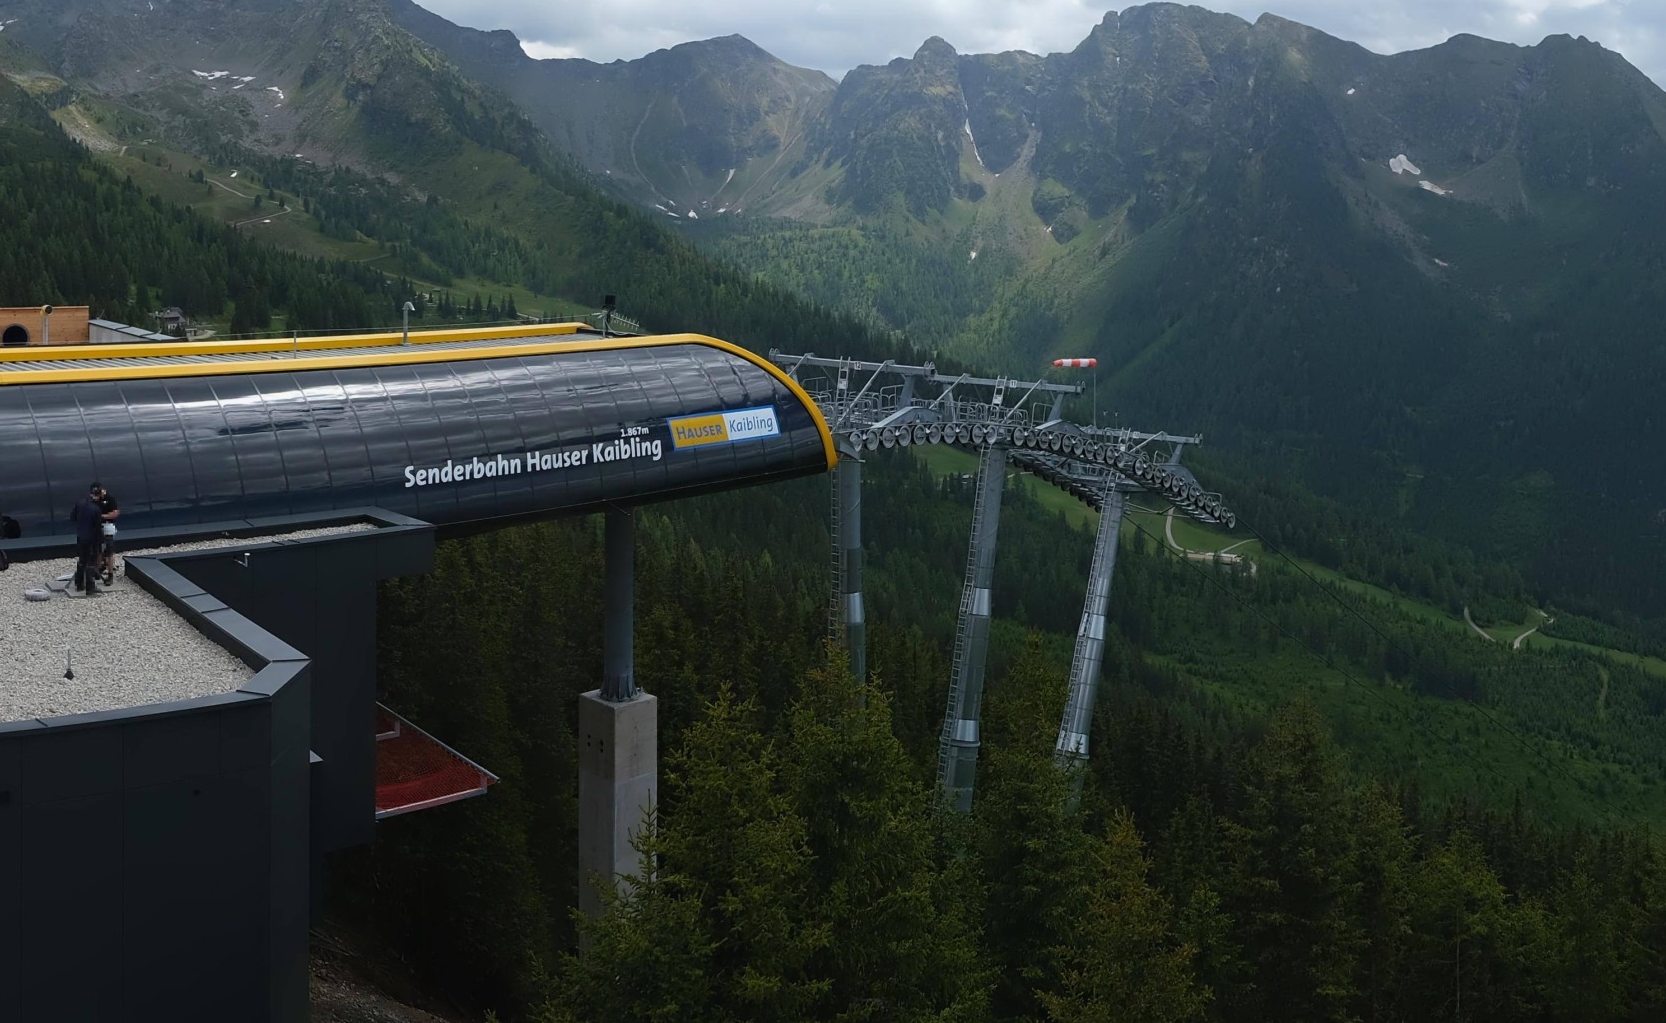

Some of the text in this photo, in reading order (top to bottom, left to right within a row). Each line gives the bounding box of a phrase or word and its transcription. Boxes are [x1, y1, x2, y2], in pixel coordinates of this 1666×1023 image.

[620, 426, 649, 437] 1.867m
[676, 416, 773, 440] HAUSER Kaibling
[404, 436, 662, 488] Senderbahn Hauser Kaibling
